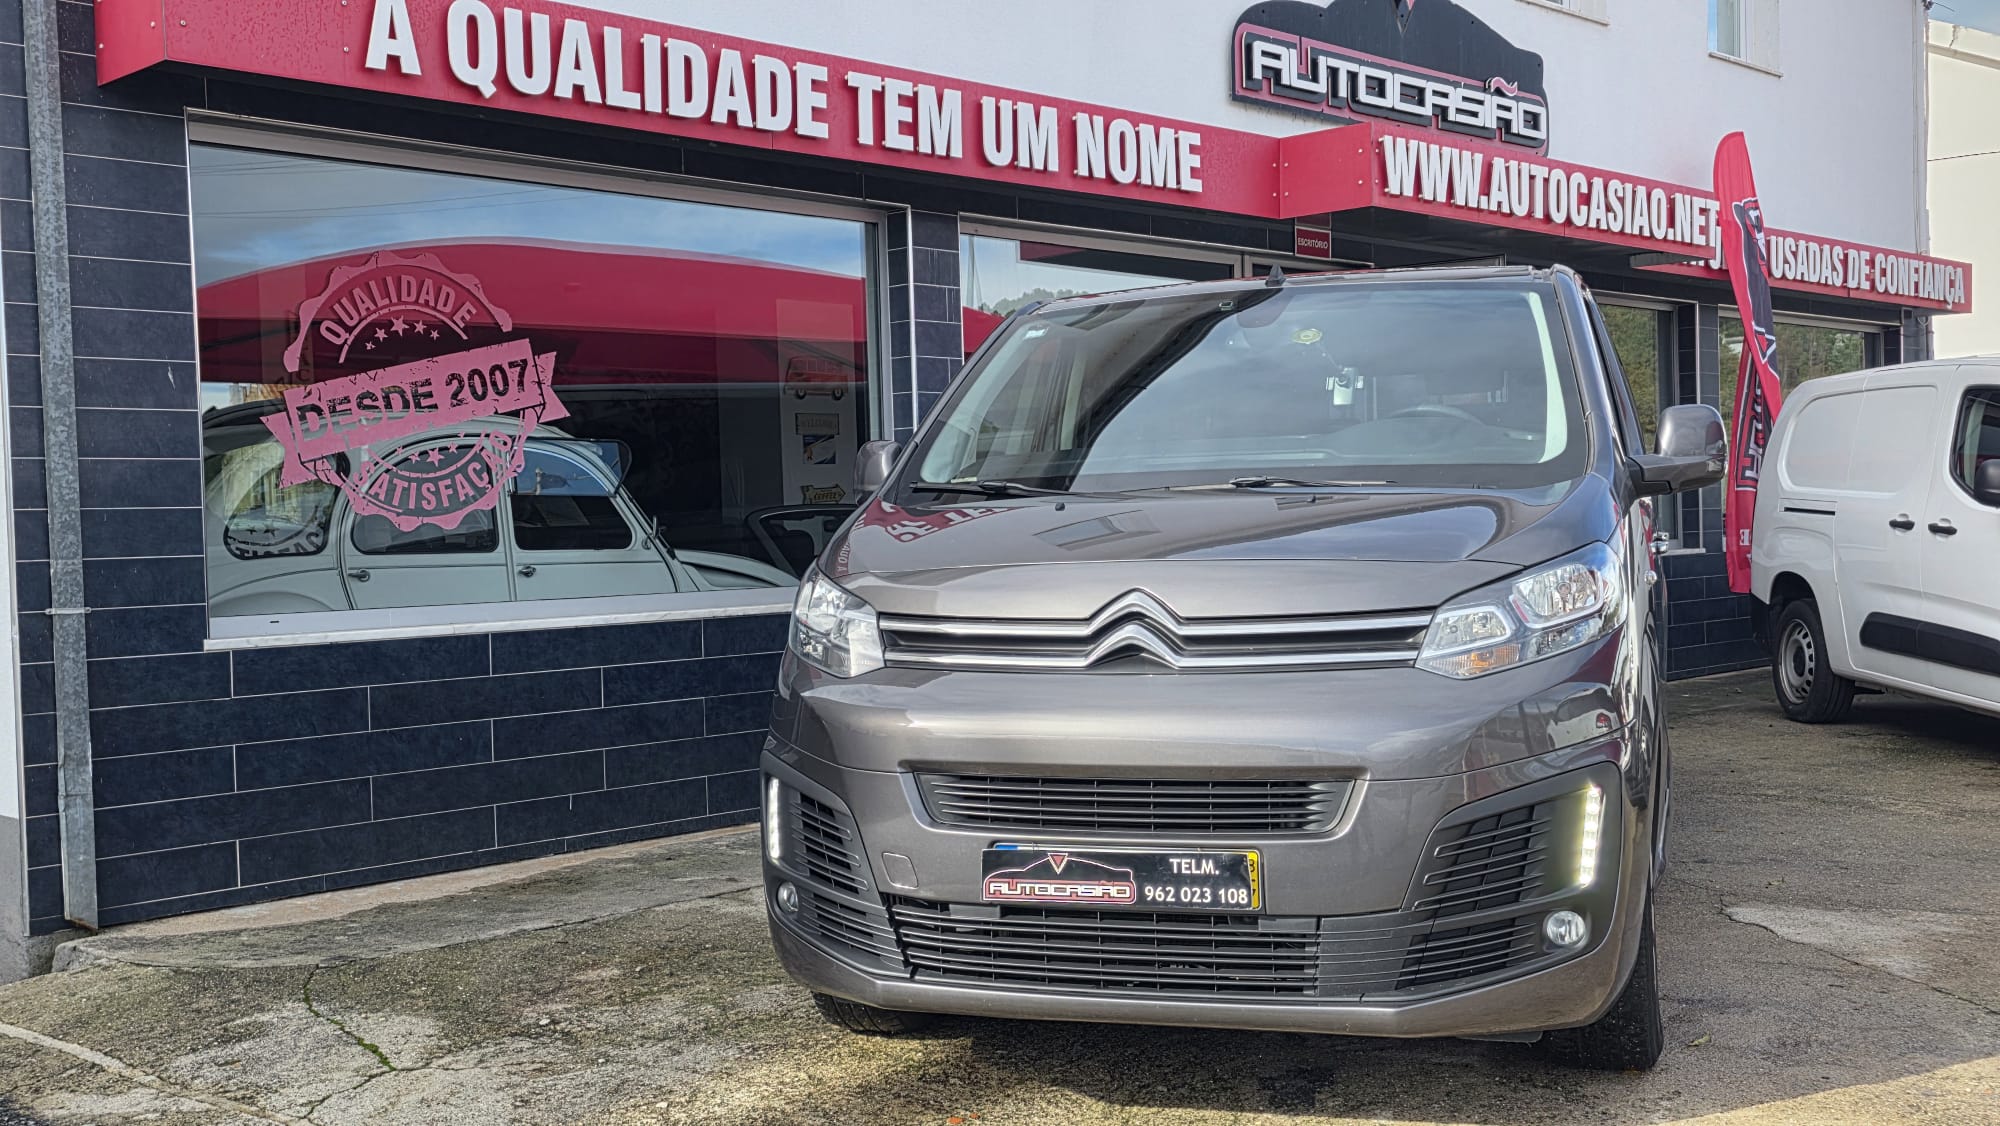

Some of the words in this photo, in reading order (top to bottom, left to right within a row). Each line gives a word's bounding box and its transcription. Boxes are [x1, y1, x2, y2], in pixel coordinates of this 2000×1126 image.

[365, 0, 421, 75] A
[446, 0, 829, 139] QUALIDADE
[847, 71, 963, 159] TEM
[981, 95, 1060, 172] UM
[1074, 112, 1203, 193] NOME
[1252, 40, 1547, 140] AUTOCASIÃO
[1383, 134, 1720, 248] WWW.AUTOCASIAO.NET
[1297, 237, 1329, 250] ESCRITÓRIO
[1769, 235, 1844, 288] USADAS
[1847, 248, 1871, 290] DE
[1874, 252, 1966, 310] CONFIANÇA
[319, 274, 478, 347] QUALIDADE
[296, 377, 439, 443] DESDE
[444, 358, 530, 408] 2007
[1144, 886, 1176, 902] 962
[1180, 887, 1212, 903] 023
[1218, 888, 1249, 904] 108
[1169, 858, 1220, 876] TELM.
